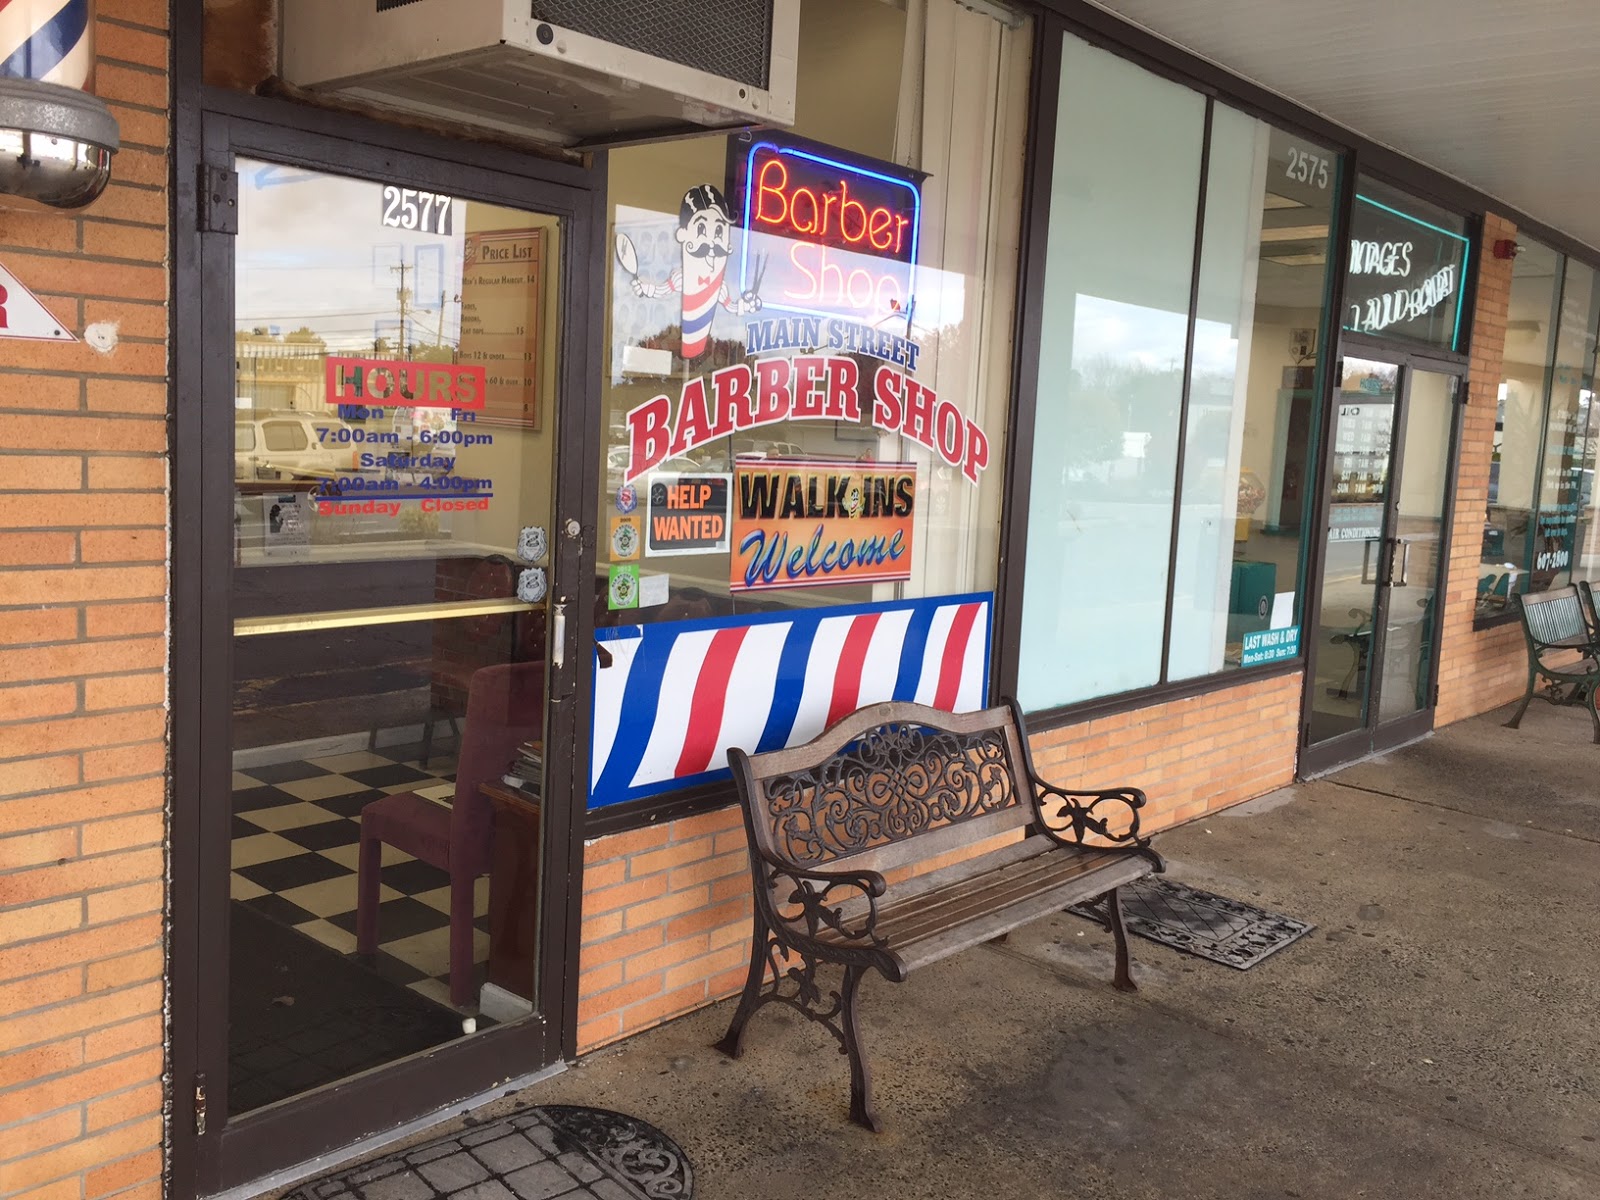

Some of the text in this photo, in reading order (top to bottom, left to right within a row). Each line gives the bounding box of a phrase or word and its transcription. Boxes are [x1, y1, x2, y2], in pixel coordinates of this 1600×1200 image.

[1286, 147, 1328, 189] 2575
[383, 185, 451, 235] 2577
[755, 160, 909, 253] Barber
[527, 275, 534, 284] 14
[783, 242, 901, 316] Shop
[474, 351, 481, 360] 12
[483, 352, 488, 360] &
[746, 316, 920, 372] MAIN STREET
[335, 364, 477, 402] HOURS
[489, 377, 498, 385] 60
[337, 404, 476, 422] Mon Fri
[624, 355, 990, 487] BARBER SHOP
[316, 428, 399, 444] 7:00am
[420, 430, 493, 447] 6:00pm
[360, 453, 456, 471] Saturday
[317, 477, 399, 492] 7:00am
[420, 476, 492, 492] 4:00pm
[739, 470, 849, 519] WALK
[1337, 482, 1348, 494] SUN
[1355, 483, 1366, 494] 7AM
[319, 497, 489, 517] Sunday Closed
[666, 484, 712, 510] HELP
[653, 515, 724, 542] WANTED
[1330, 528, 1340, 540] AIR
[739, 523, 906, 587] Welcome
[1245, 628, 1298, 650] LAST WASH & DRY
